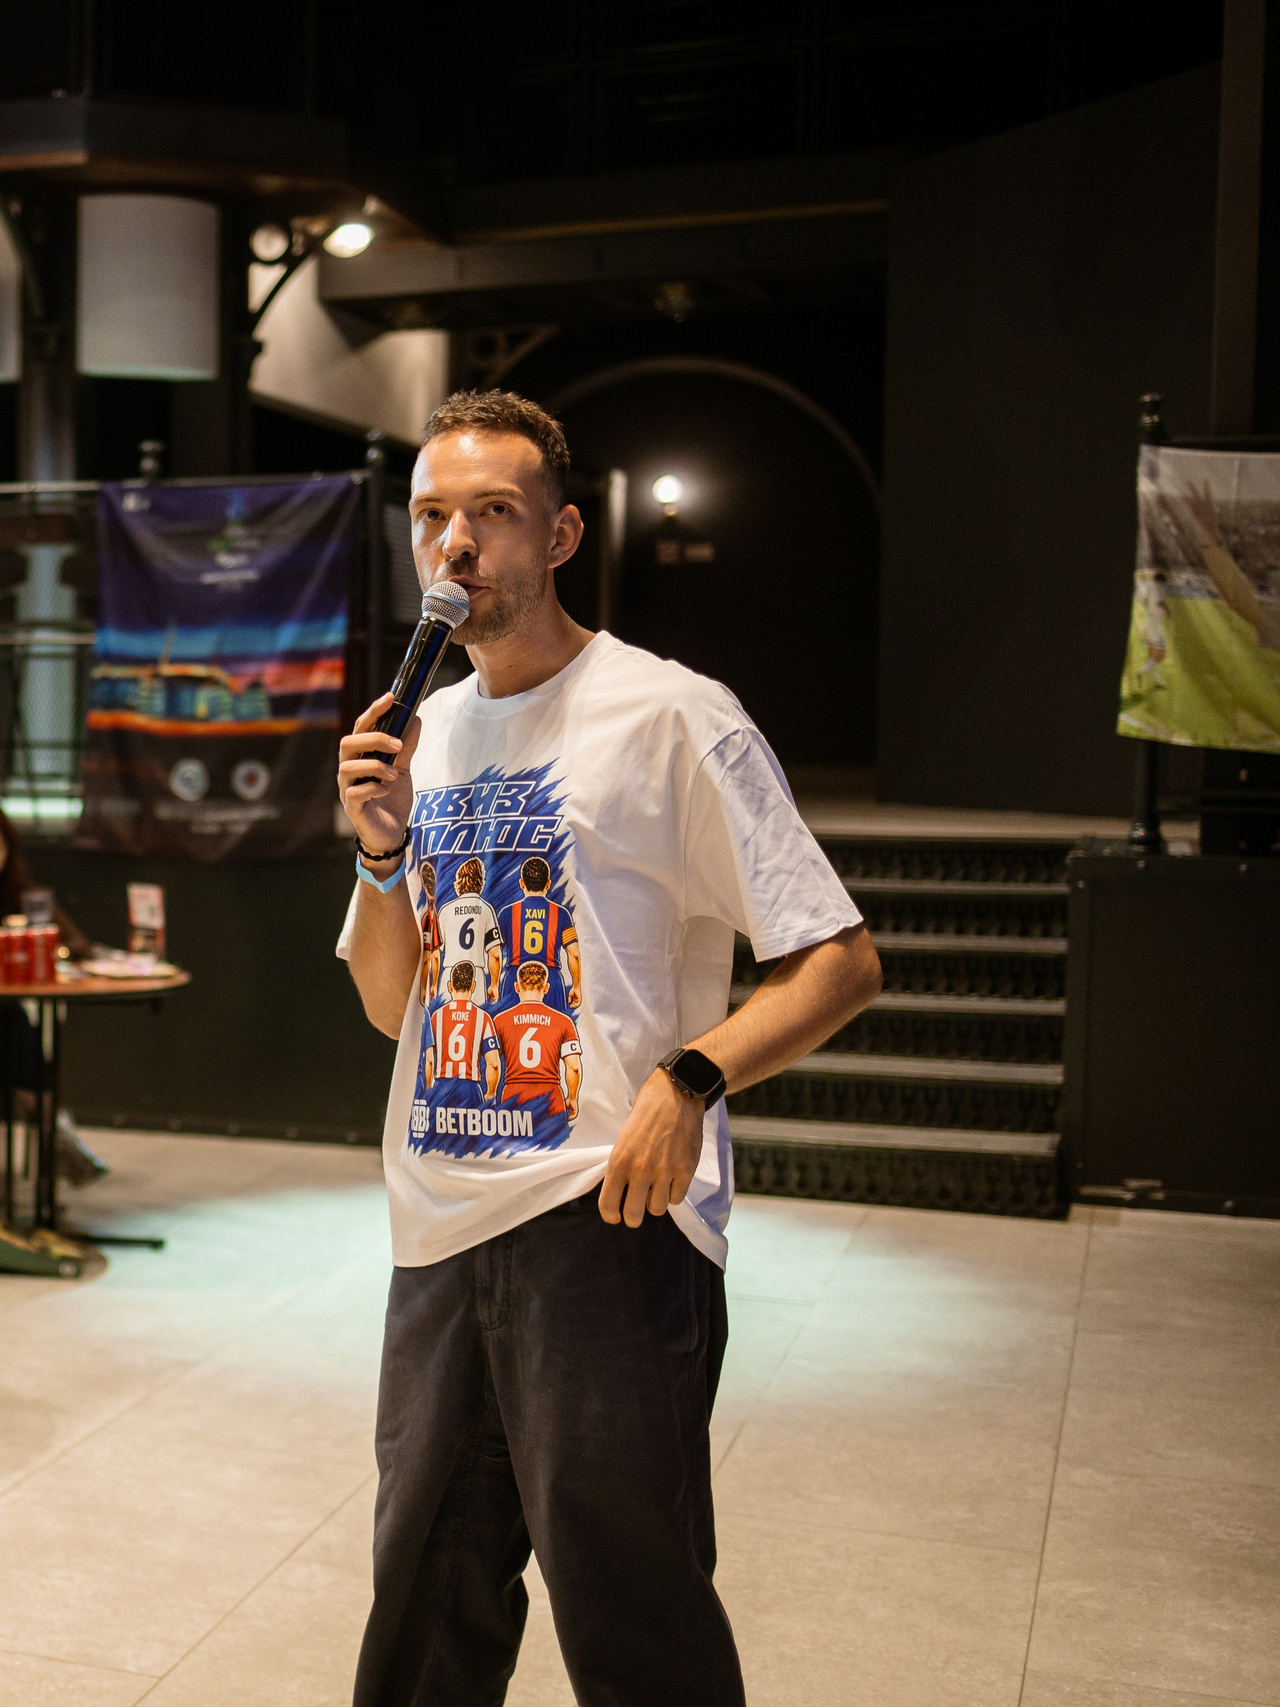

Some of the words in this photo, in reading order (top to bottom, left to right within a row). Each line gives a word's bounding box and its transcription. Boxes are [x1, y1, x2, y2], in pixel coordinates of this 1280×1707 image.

[412, 781, 537, 828] КВИЗ
[421, 816, 563, 859] ПЛЮС
[455, 905, 482, 916] REDONDO
[525, 908, 546, 919] XAVI
[459, 918, 475, 950] 6
[493, 928, 499, 938] C
[523, 920, 544, 954] 6
[451, 1011, 470, 1021] KOKE
[513, 1013, 551, 1027] KIMMICH
[448, 1023, 466, 1061] 6
[487, 1038, 495, 1049] C
[520, 1027, 542, 1069] 6
[570, 1042, 577, 1052] C
[435, 1106, 533, 1137] BETBOOM
